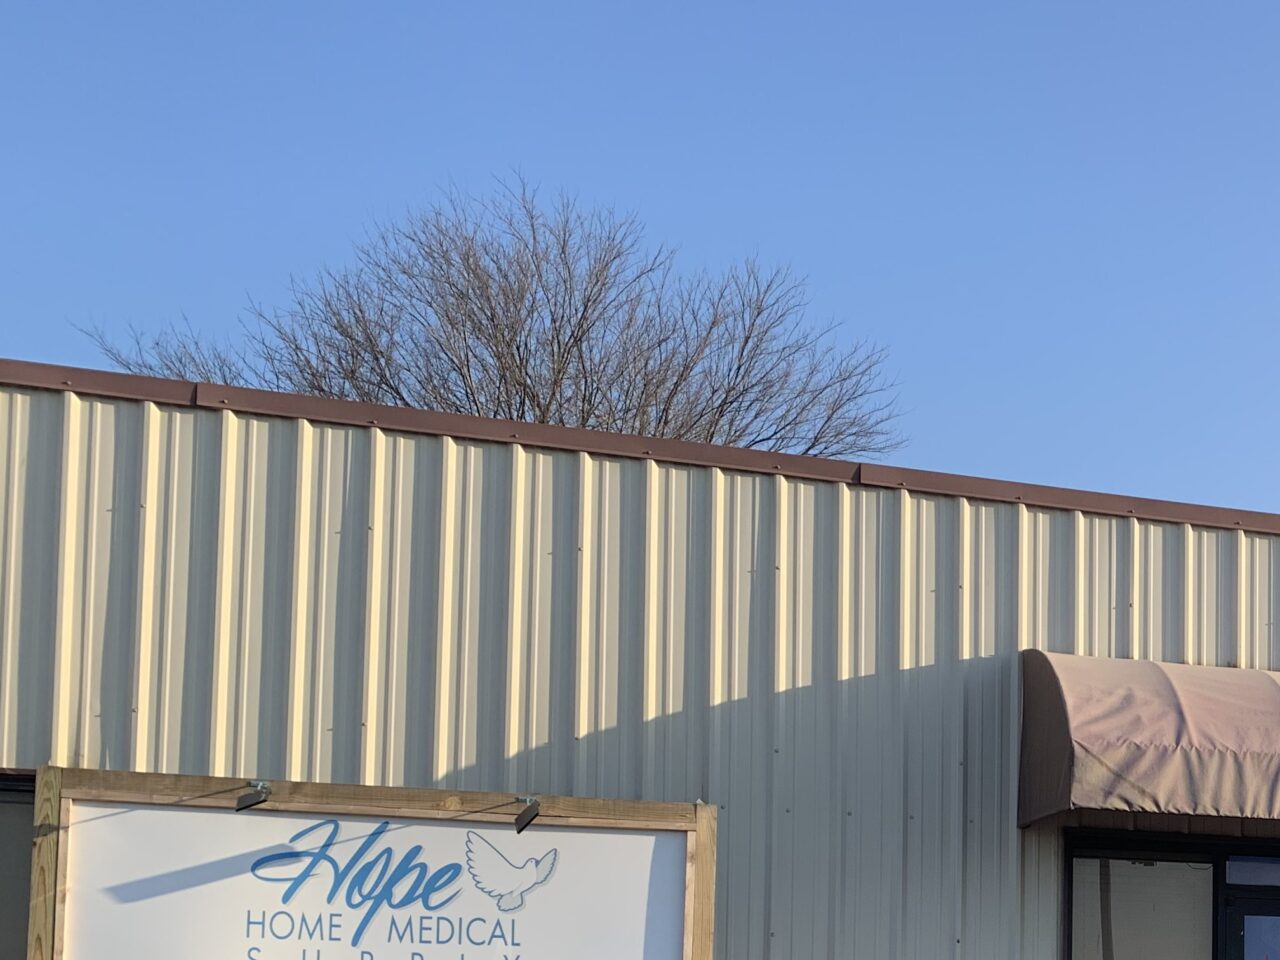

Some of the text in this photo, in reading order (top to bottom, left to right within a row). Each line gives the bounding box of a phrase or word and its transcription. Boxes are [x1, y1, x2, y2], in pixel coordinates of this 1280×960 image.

[251, 819, 463, 947] Hope
[246, 910, 521, 947] HOME MEDICAL
